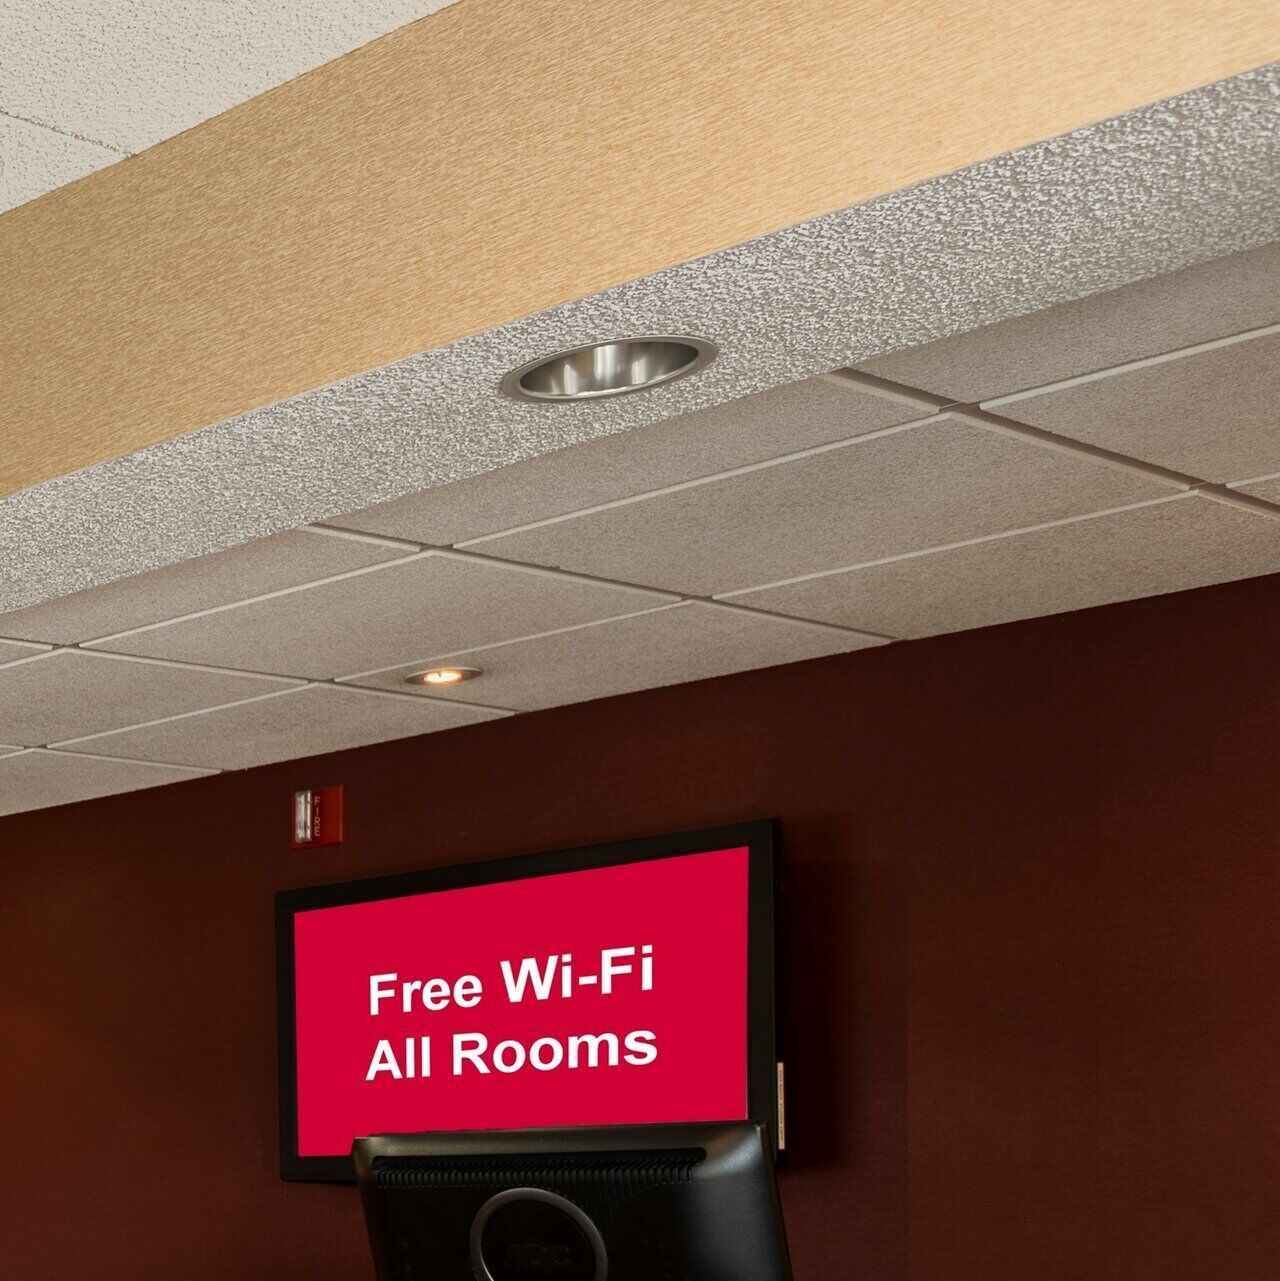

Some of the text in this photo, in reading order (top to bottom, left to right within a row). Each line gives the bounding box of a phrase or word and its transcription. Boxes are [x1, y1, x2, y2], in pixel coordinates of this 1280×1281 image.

[368, 945, 655, 1016] Free Wi-Fi
[365, 1028, 658, 1081] All Rooms
